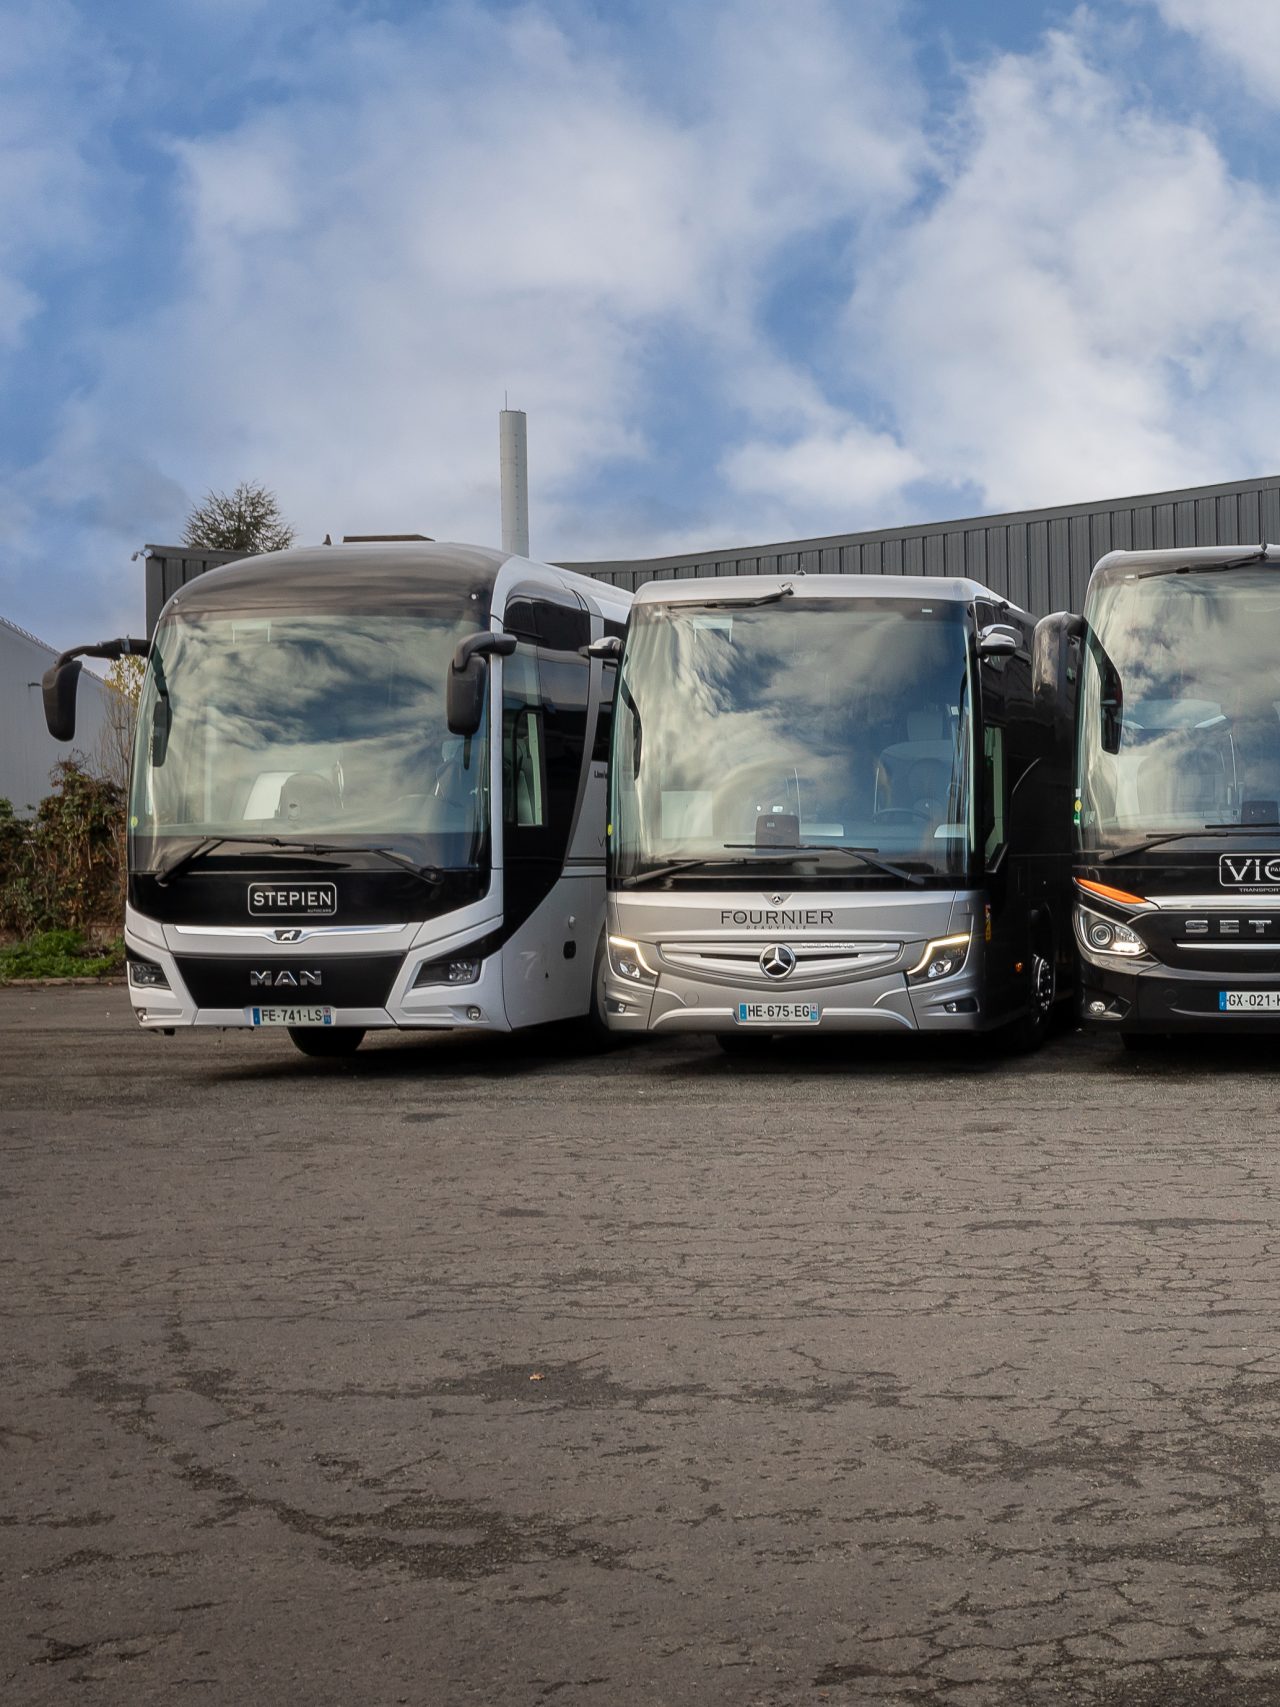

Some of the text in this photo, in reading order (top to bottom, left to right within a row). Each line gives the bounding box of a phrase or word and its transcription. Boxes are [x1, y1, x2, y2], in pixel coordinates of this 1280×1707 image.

[253, 891, 332, 906] STEPIEN
[721, 910, 834, 925] FOURNIER
[250, 970, 322, 986] MAN
[261, 1009, 322, 1022] FE-741-LS
[747, 1004, 810, 1018] HE-675-EG
